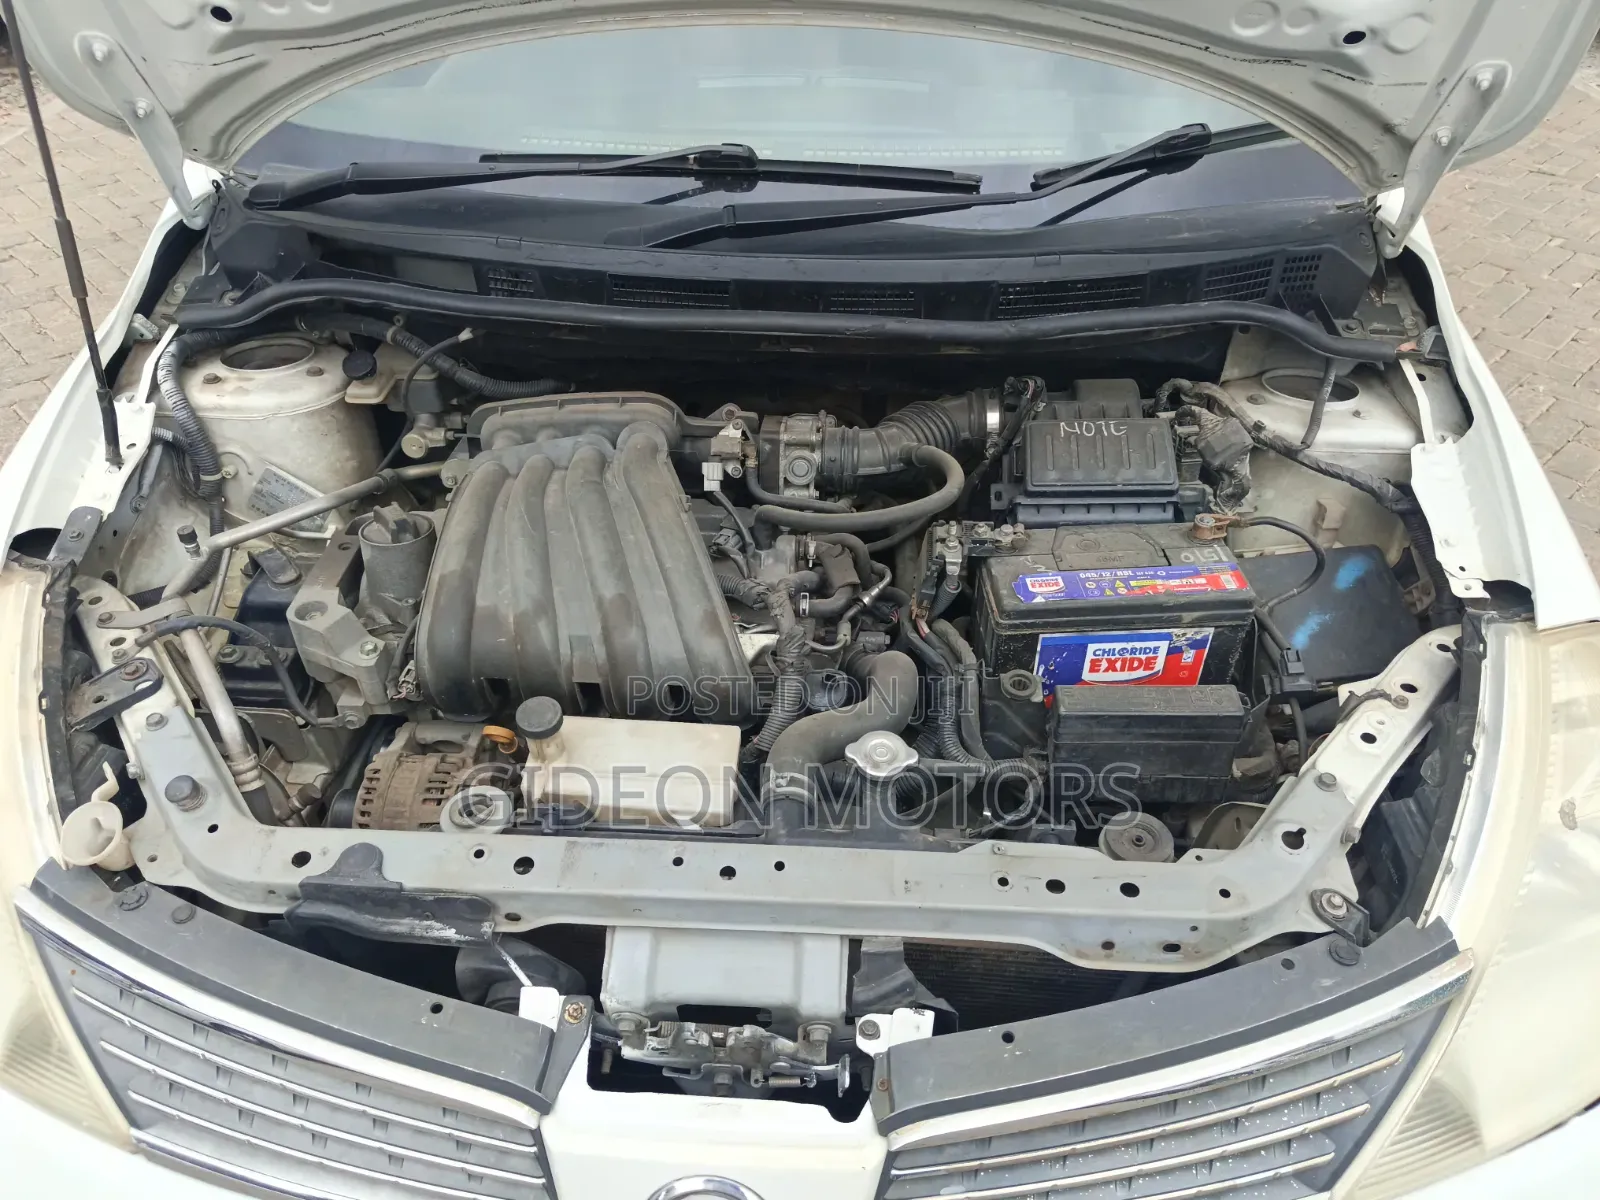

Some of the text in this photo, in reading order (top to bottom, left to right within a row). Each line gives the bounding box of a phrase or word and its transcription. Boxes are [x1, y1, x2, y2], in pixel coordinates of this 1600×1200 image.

[1060, 421, 1127, 437] NOTE
[1092, 646, 1160, 656] CHLORIDE
[1088, 656, 1158, 673] EXIDE
